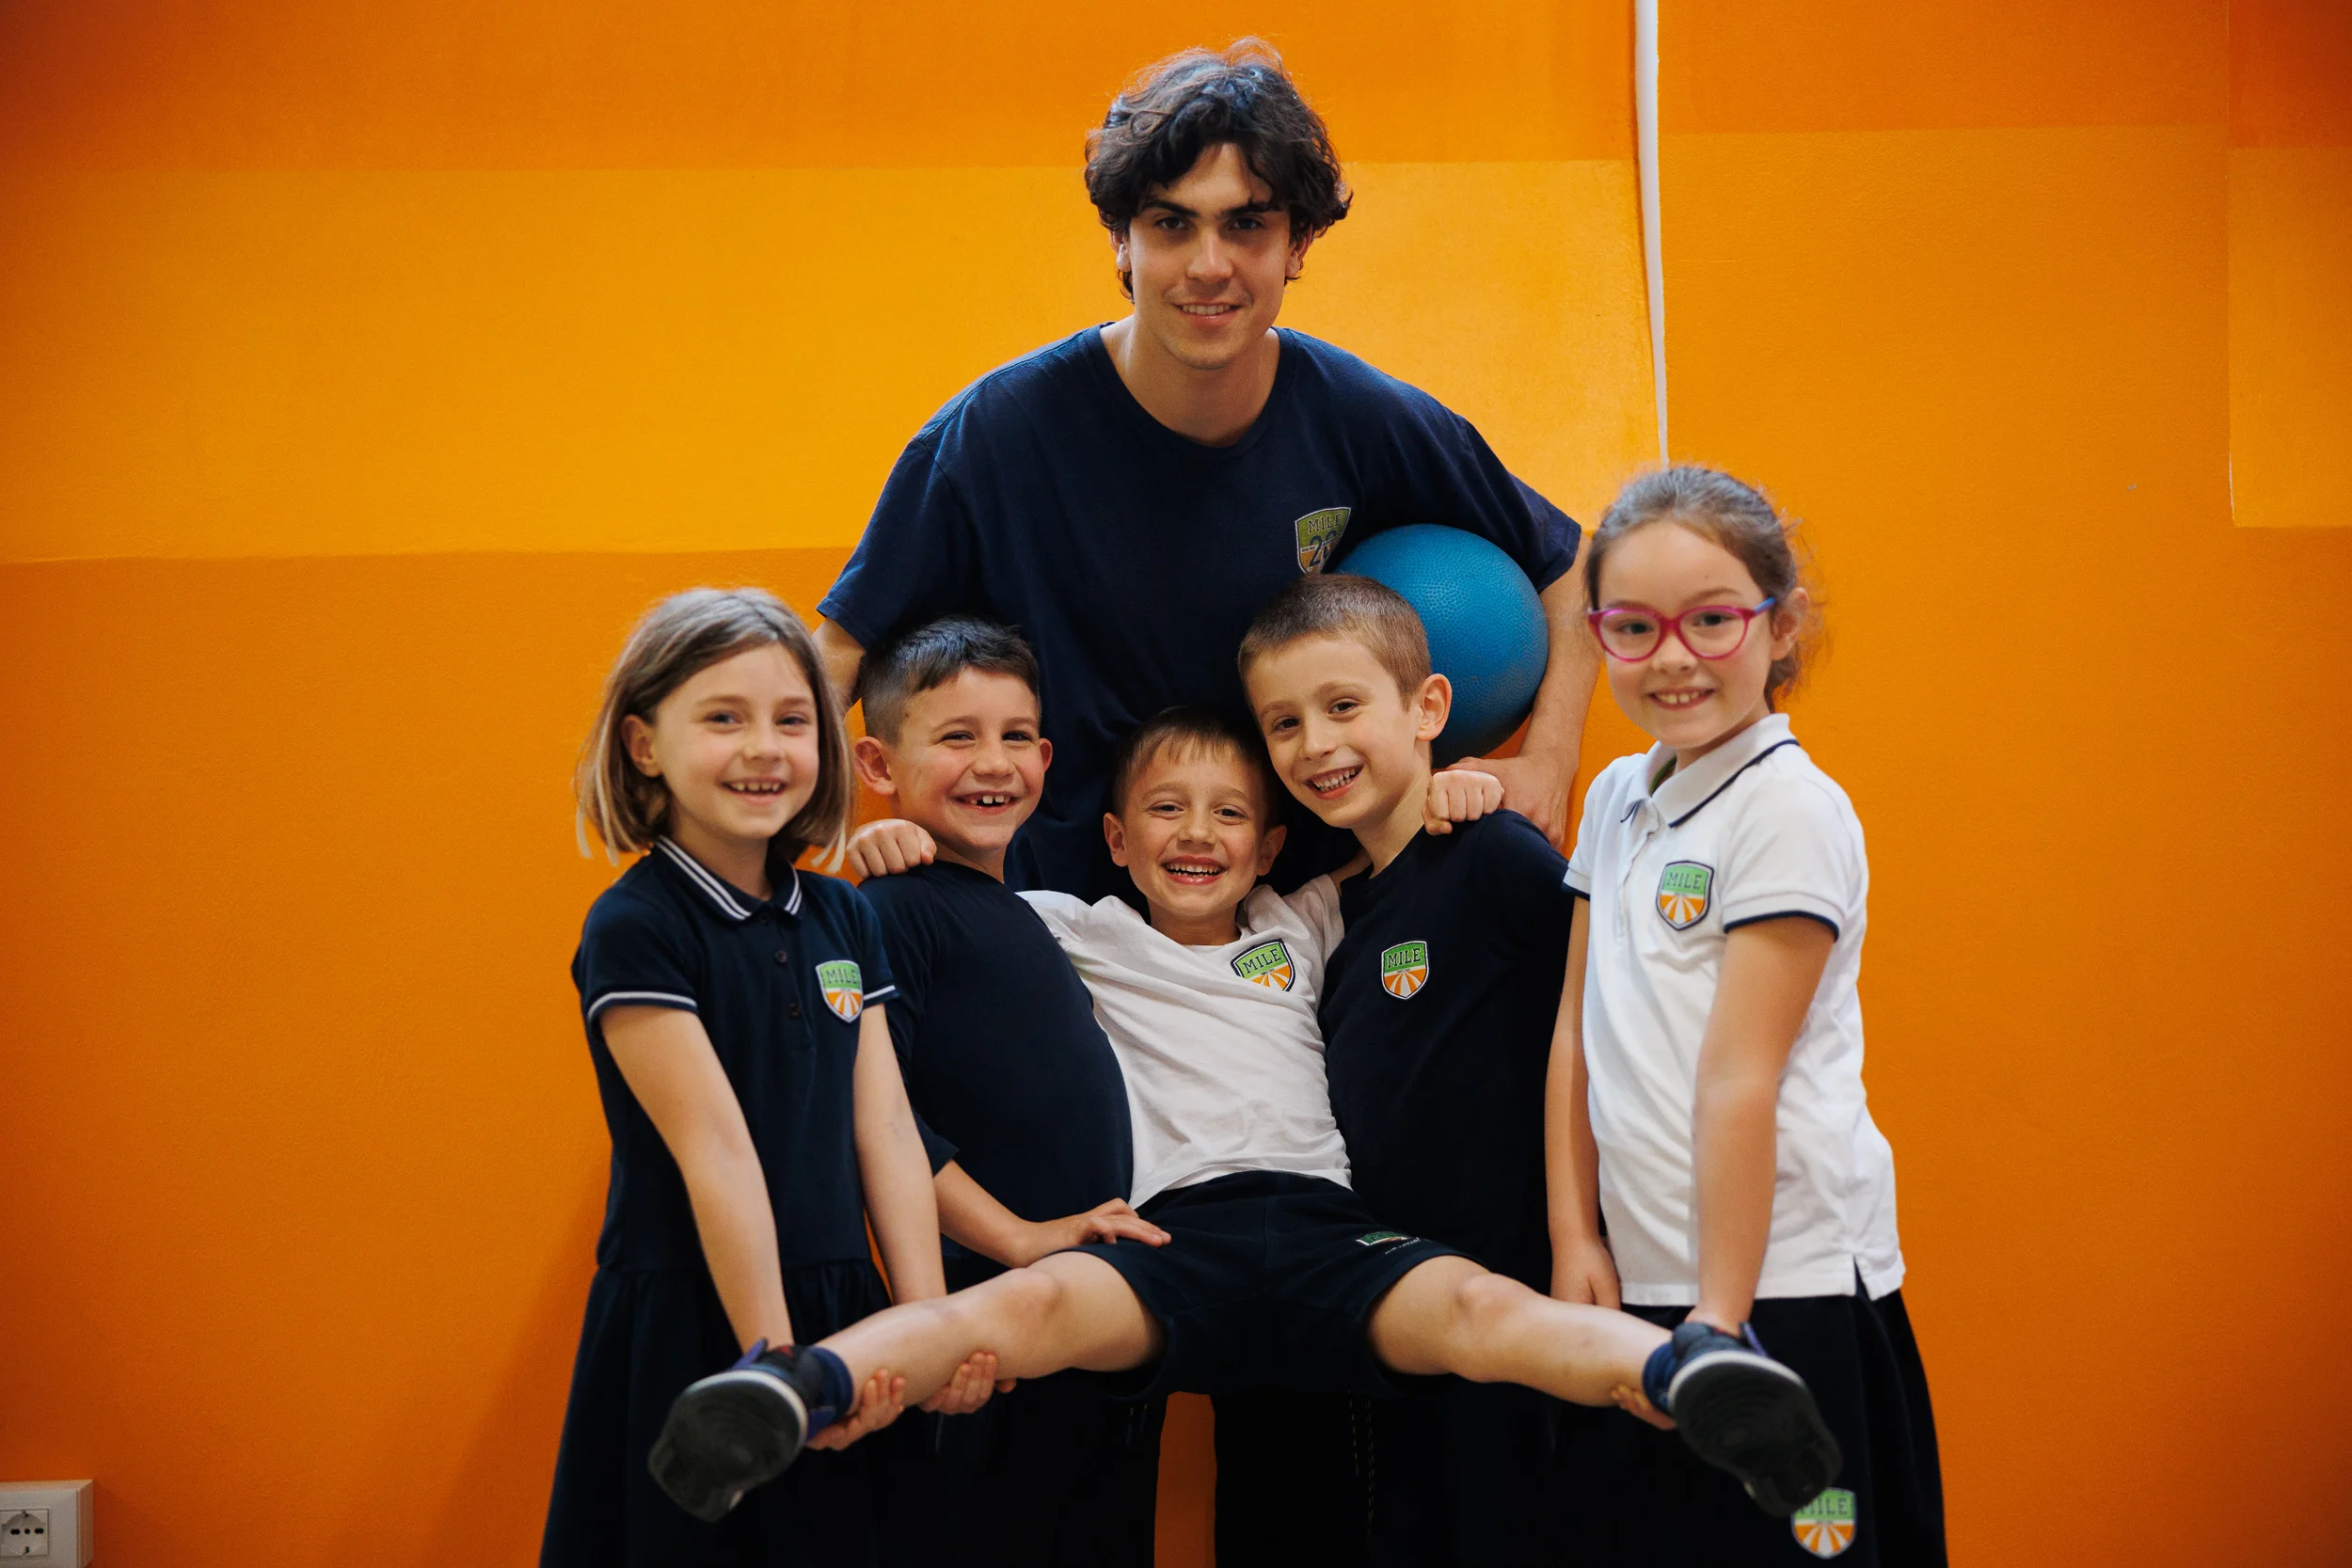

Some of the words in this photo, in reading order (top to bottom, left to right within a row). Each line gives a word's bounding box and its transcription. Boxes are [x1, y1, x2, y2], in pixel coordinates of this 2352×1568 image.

[1308, 512, 1343, 534] MILE
[1666, 872, 1703, 890] MILE
[1242, 948, 1281, 974] MILE
[1388, 948, 1422, 969] MILE
[826, 968, 858, 985] MILE
